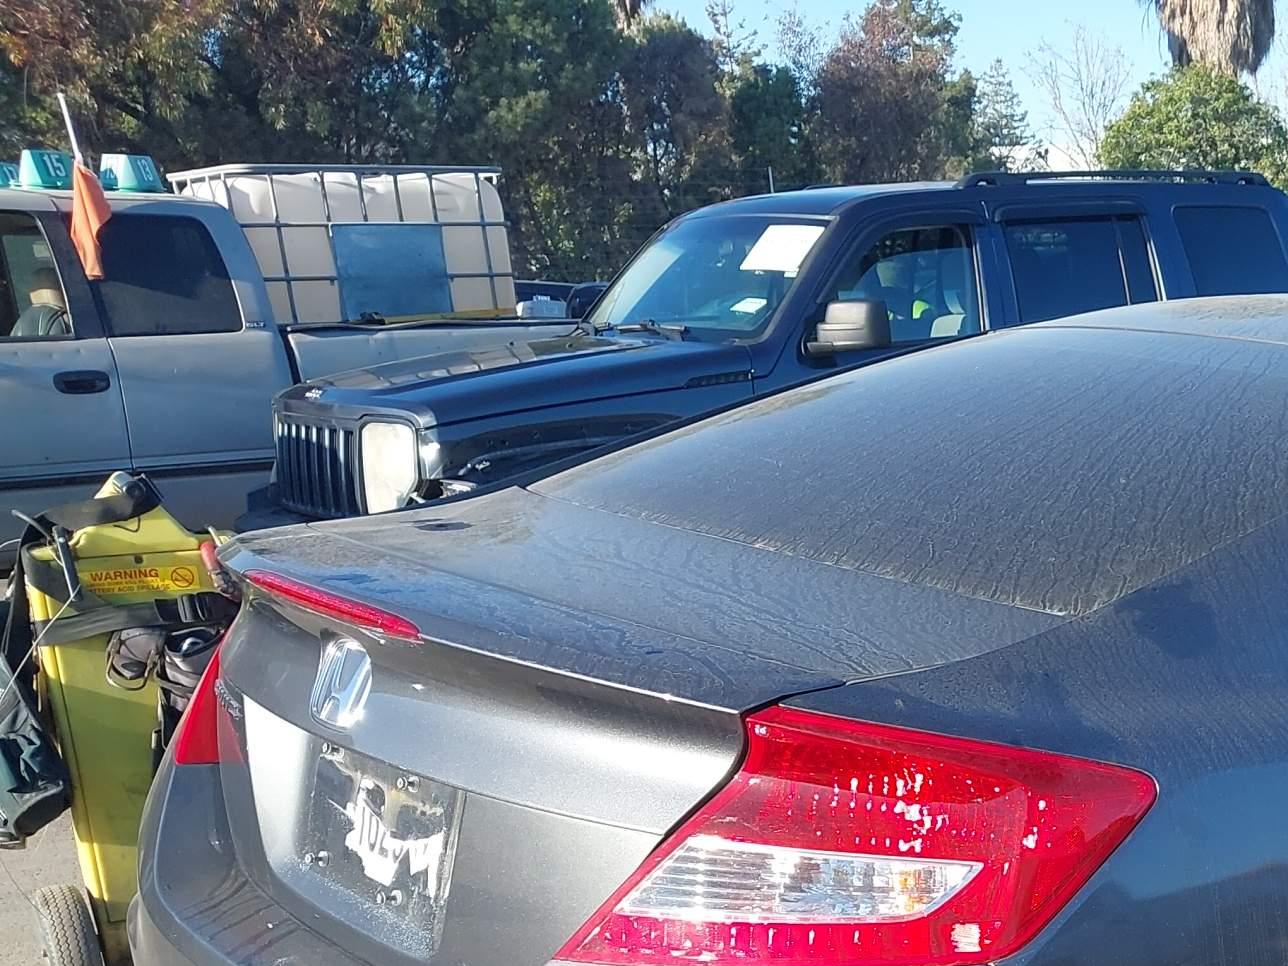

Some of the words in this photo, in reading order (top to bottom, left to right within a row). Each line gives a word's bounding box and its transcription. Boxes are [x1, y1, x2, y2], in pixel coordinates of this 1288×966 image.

[43, 153, 66, 177] 15
[136, 158, 154, 182] 13
[90, 568, 159, 582] WARNING
